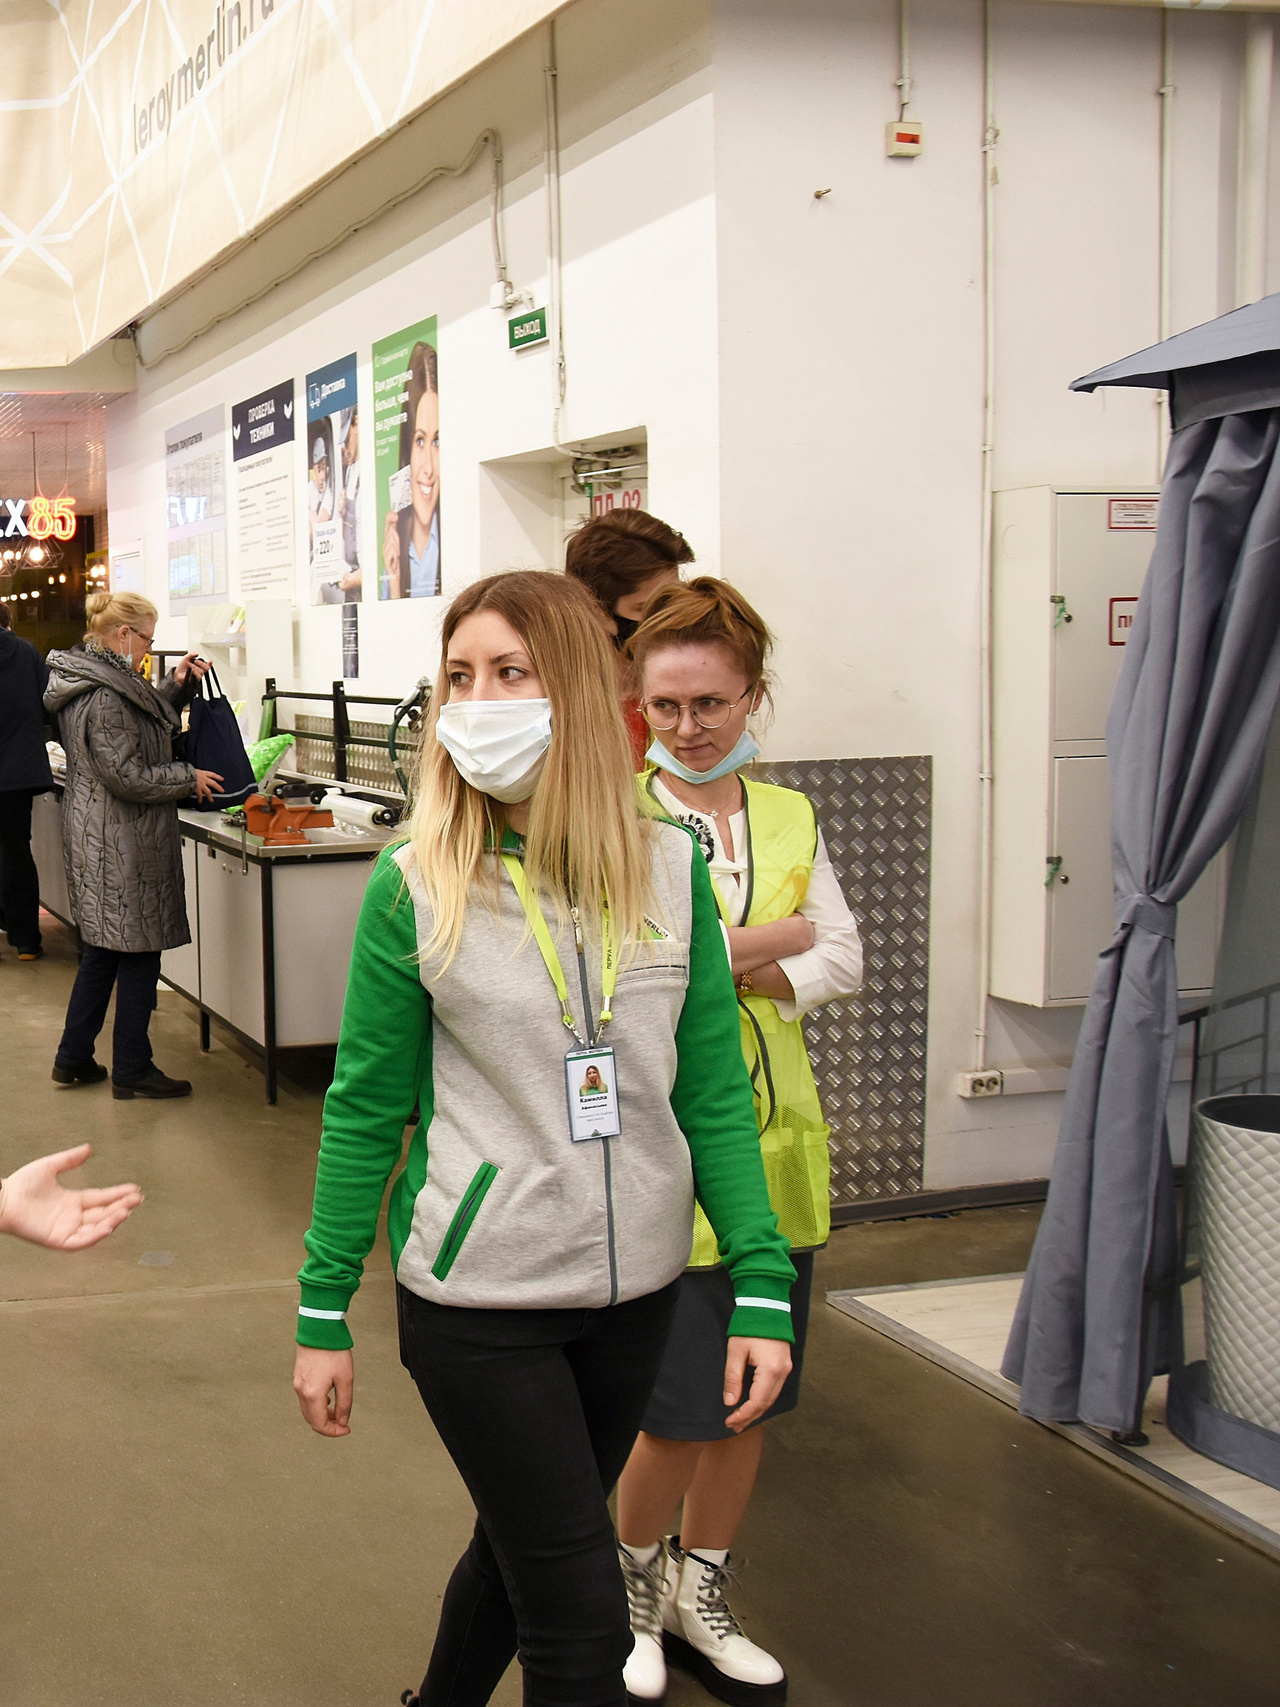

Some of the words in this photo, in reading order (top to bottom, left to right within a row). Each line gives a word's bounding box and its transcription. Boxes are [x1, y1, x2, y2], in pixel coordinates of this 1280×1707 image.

[133, 0, 274, 154] leroymerlin.ru
[514, 318, 541, 339] ВЫХОД
[321, 378, 346, 400] Доставка
[248, 399, 276, 423] ПРОВЕРКА
[249, 421, 275, 443] ТЕХНИКИ
